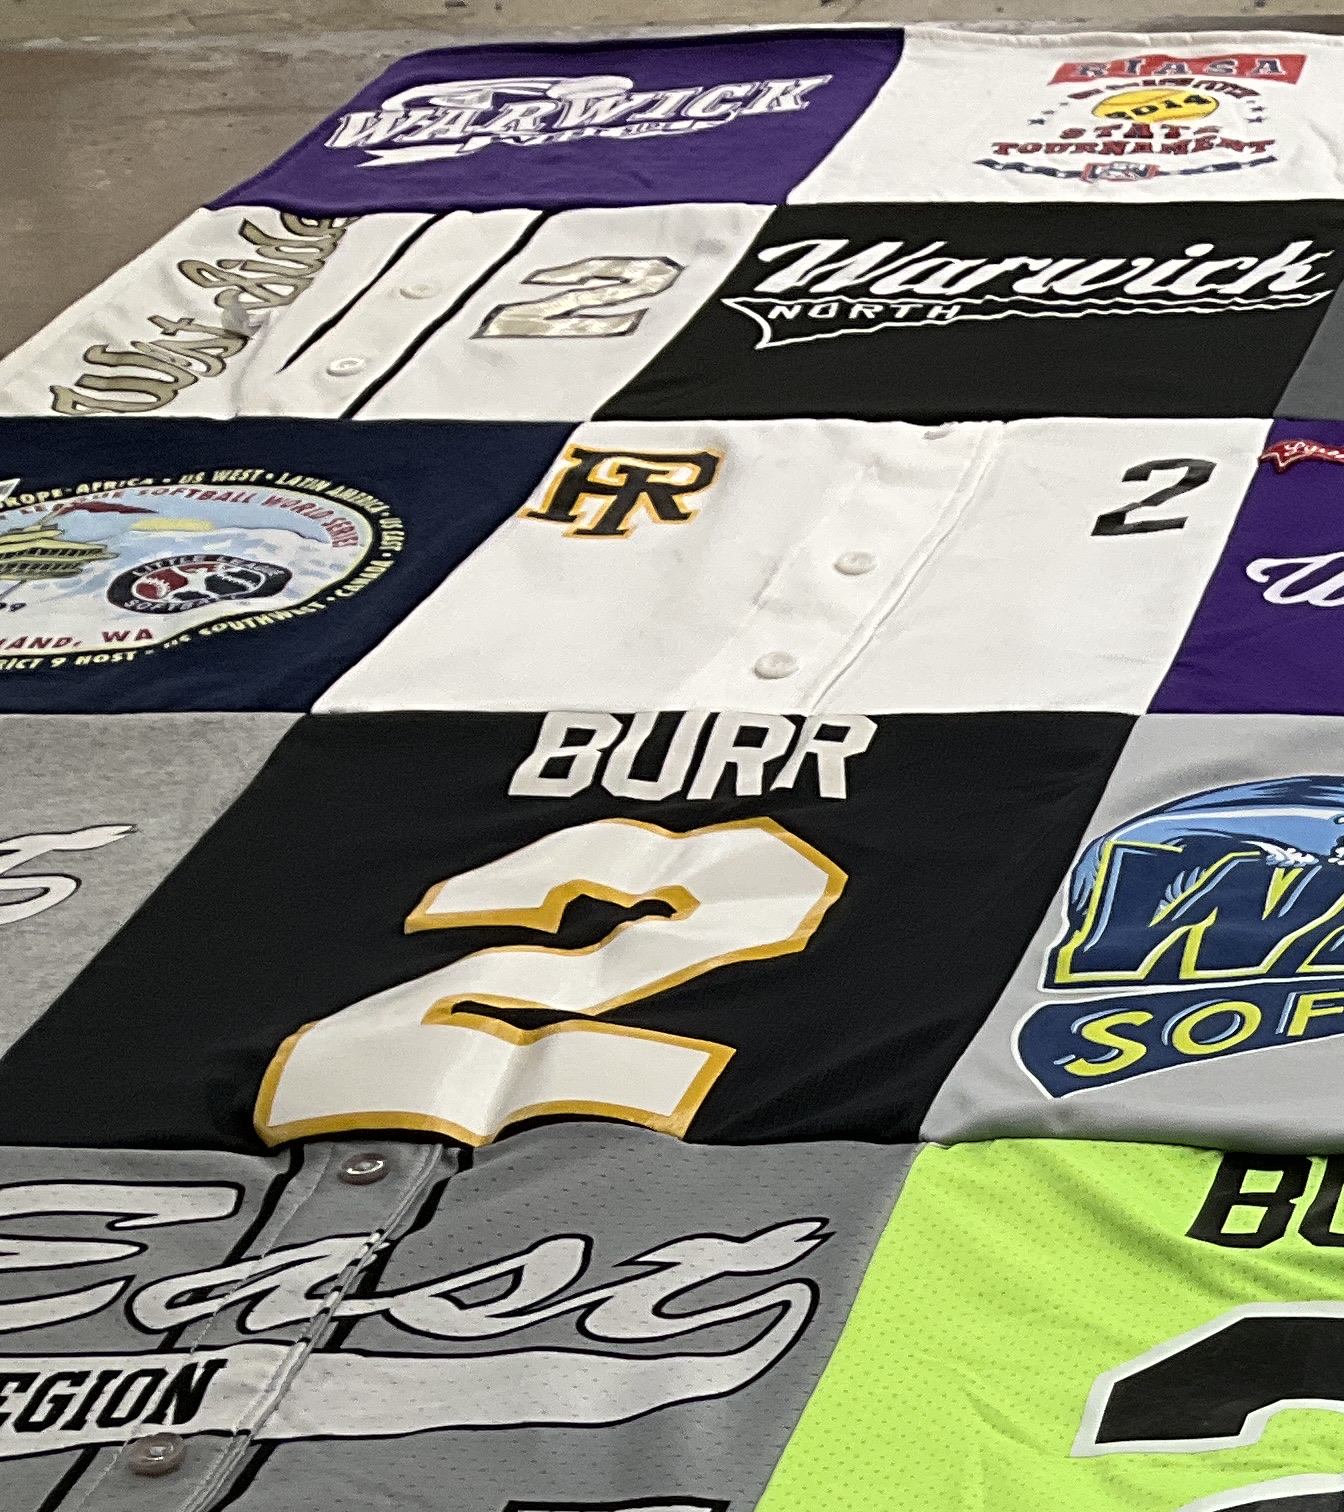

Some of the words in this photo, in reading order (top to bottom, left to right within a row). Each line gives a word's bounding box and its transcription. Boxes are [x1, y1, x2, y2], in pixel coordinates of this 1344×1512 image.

[325, 75, 833, 148] WARWICK
[991, 135, 1276, 156] TOURNAMENT
[470, 256, 686, 340] 2
[757, 239, 1336, 297] Warwick
[768, 303, 961, 322] NORTH
[211, 468, 267, 483] WEST
[1091, 458, 1218, 538] 2
[102, 628, 155, 643] WA
[508, 711, 878, 801] BURR
[251, 816, 849, 1148] 2
